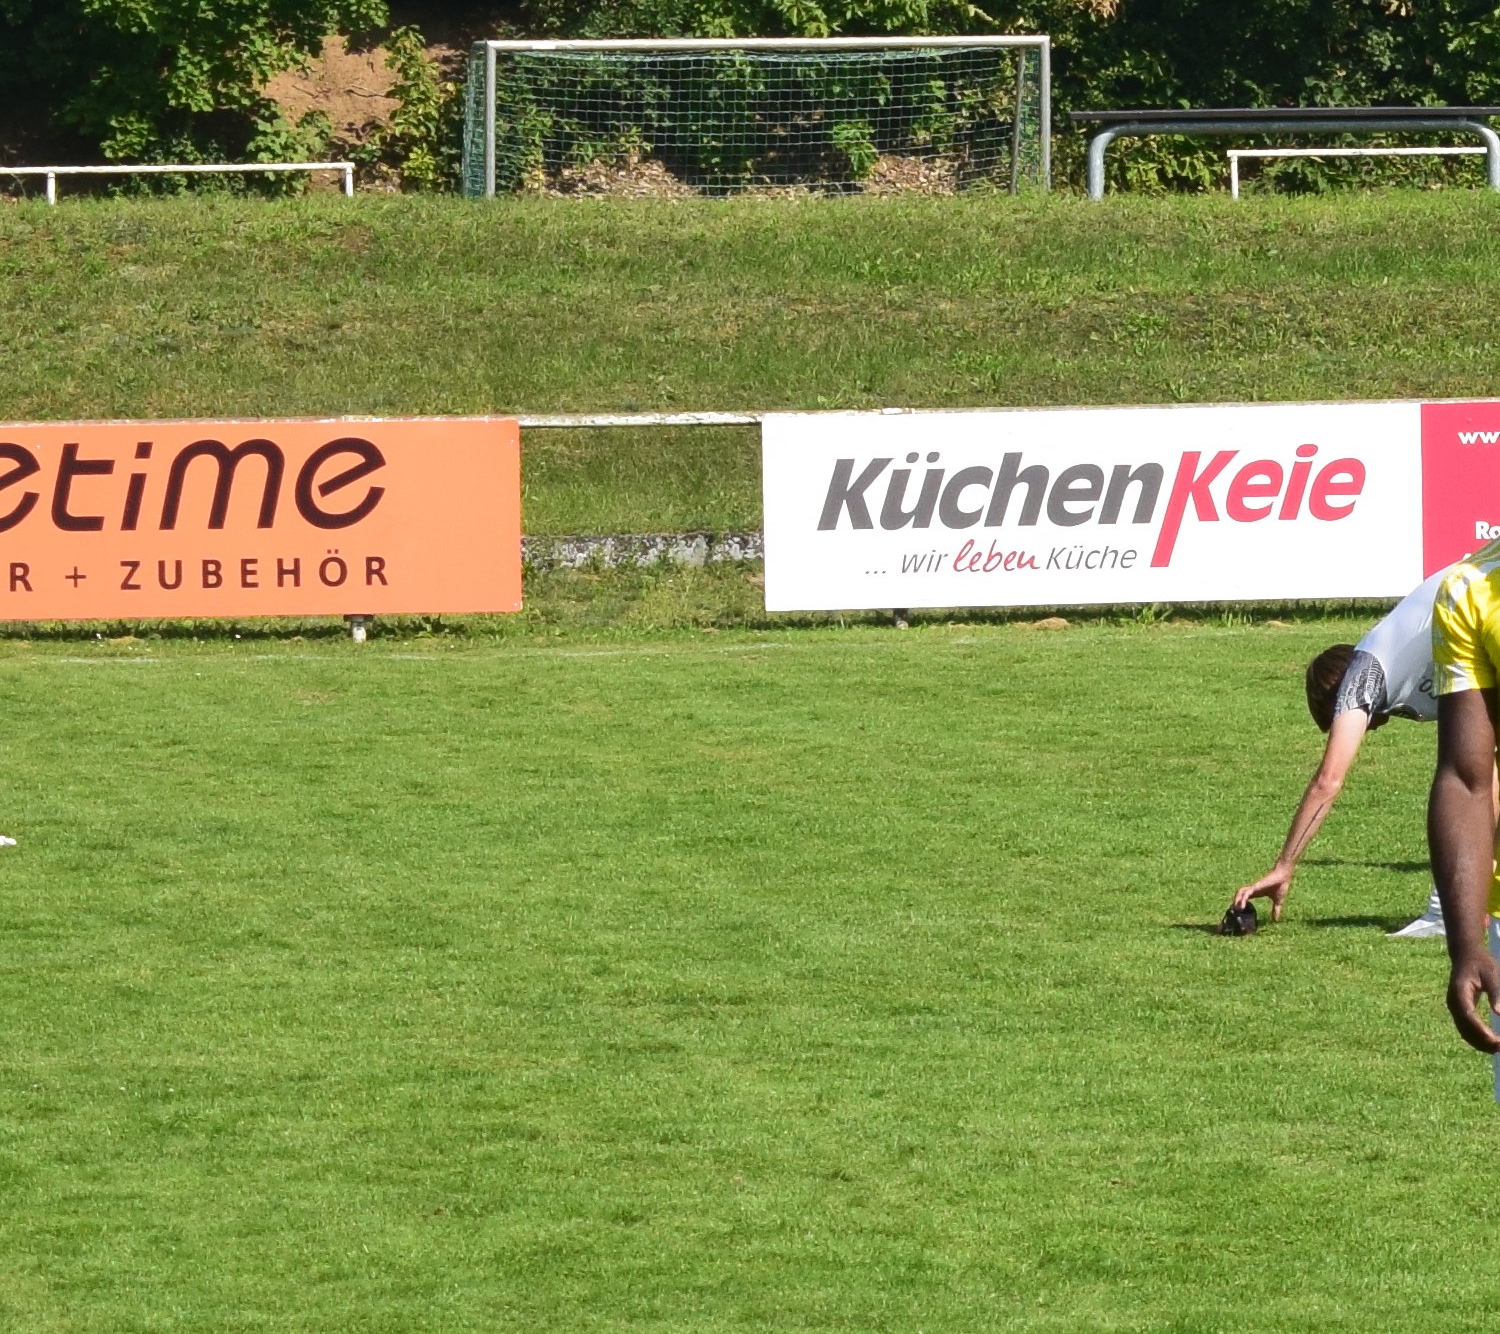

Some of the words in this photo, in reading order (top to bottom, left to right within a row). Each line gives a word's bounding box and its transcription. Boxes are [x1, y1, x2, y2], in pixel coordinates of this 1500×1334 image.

[120, 549, 389, 591] ZUBEHÖR
[901, 547, 949, 574] wir
[952, 538, 1041, 573] leben
[1046, 544, 1137, 571] Küche
